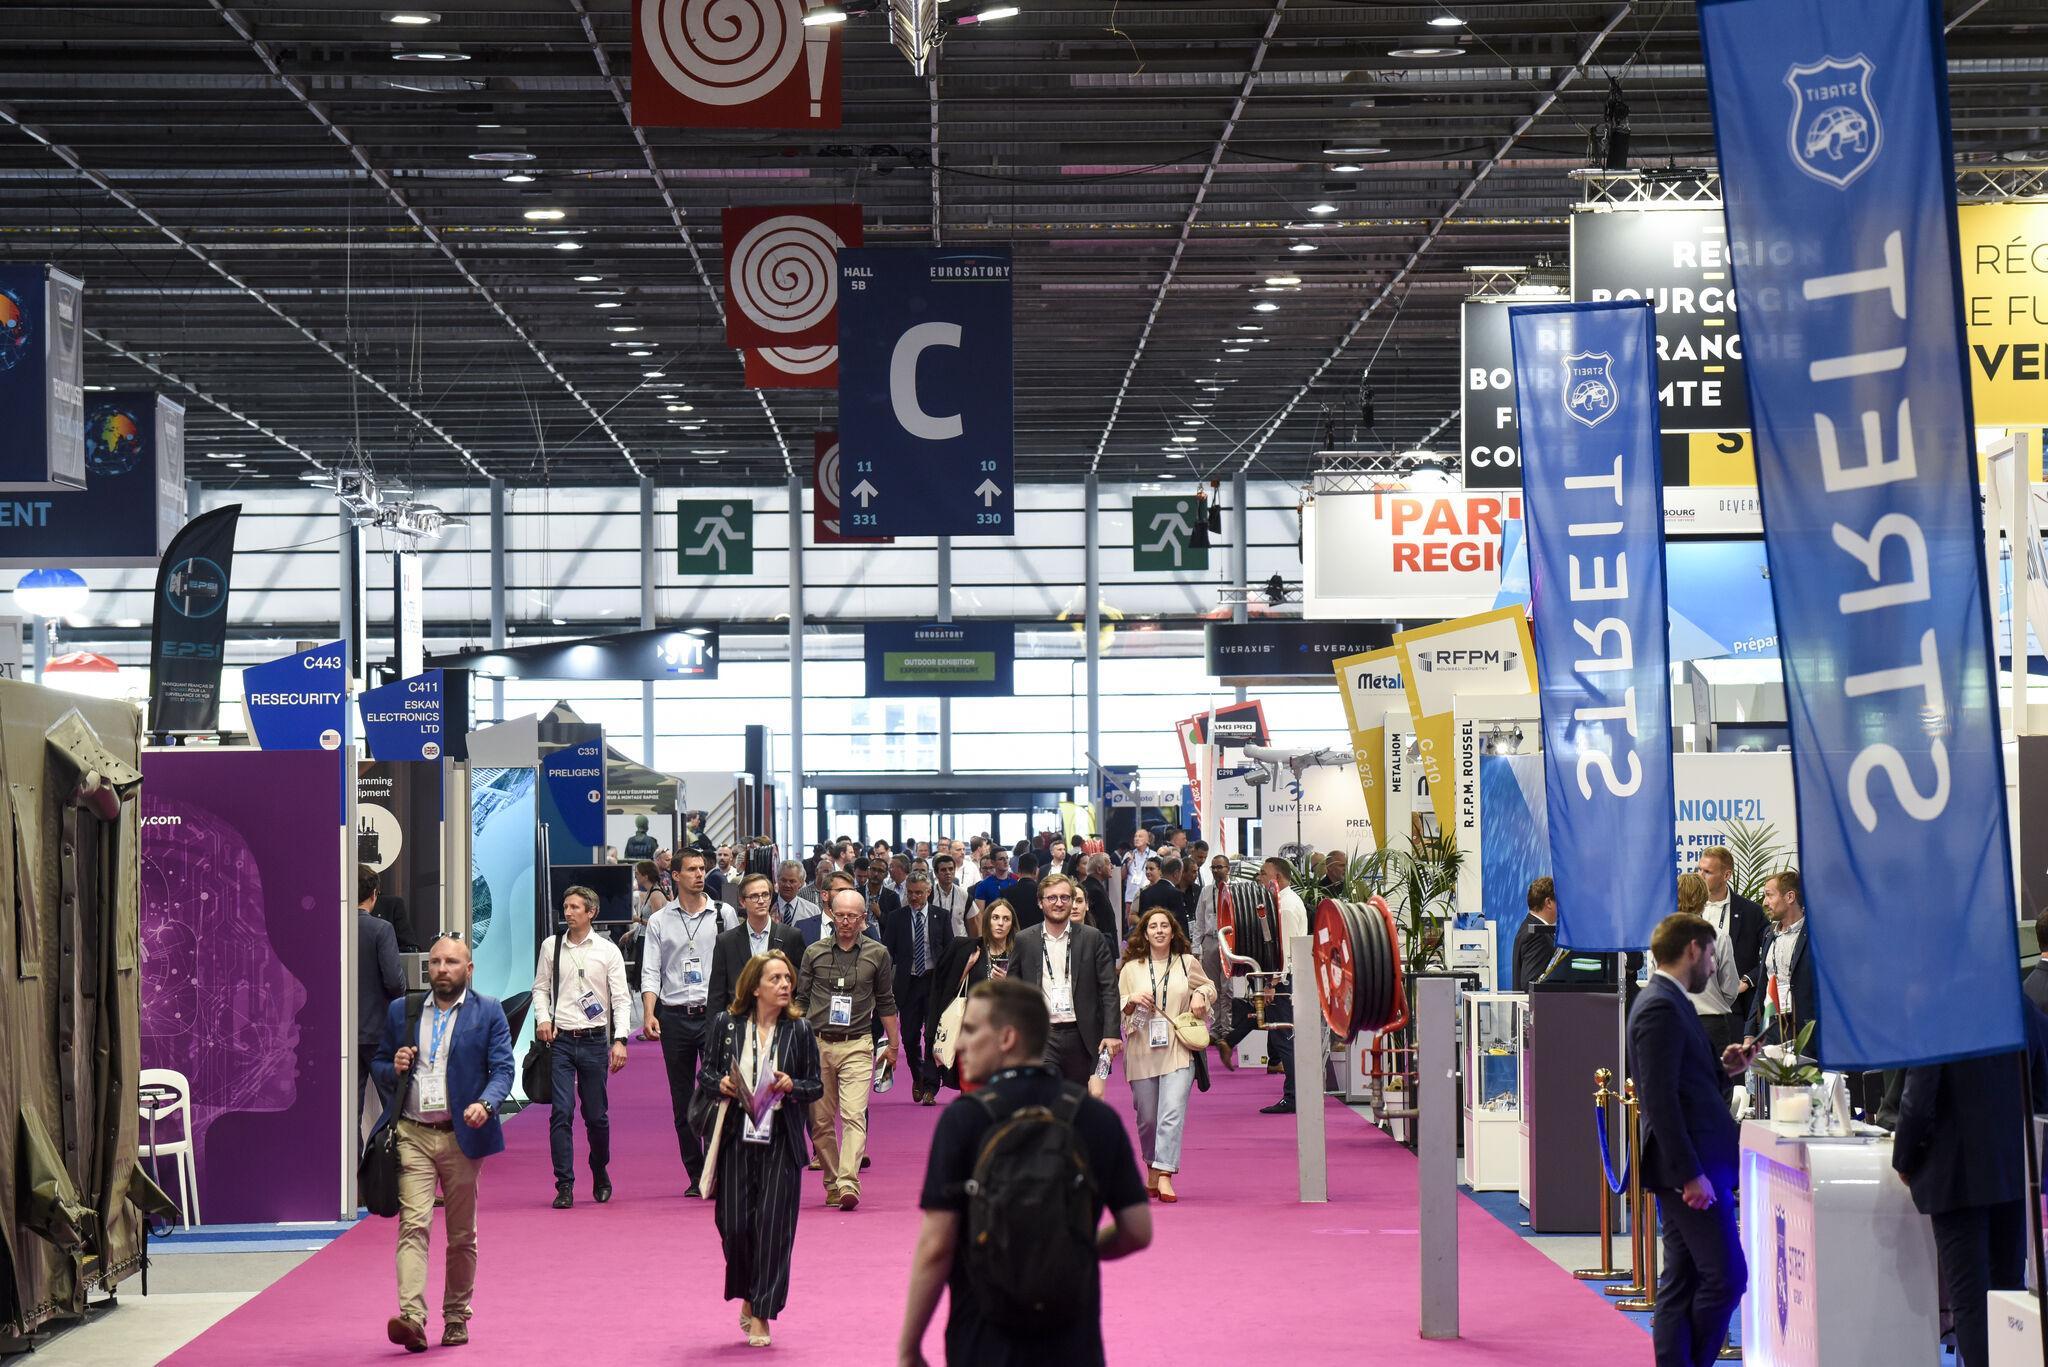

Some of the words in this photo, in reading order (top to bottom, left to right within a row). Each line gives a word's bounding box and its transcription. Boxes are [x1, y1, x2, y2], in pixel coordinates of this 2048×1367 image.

[844, 267, 874, 277] HALL
[930, 266, 1010, 277] EUROSATORY
[851, 281, 867, 290] 5B
[1972, 343, 2048, 382] VE
[889, 322, 964, 441] C
[857, 461, 873, 472] 11
[980, 460, 996, 471] 10
[0, 502, 52, 527] ENT
[853, 514, 878, 525] 331
[976, 514, 1001, 525] 330
[1392, 541, 1502, 573] REGI
[189, 580, 217, 590] EPSI
[914, 631, 964, 639] EUROSATORY
[161, 640, 221, 658] EPSI
[303, 656, 342, 669] C443
[1436, 650, 1499, 664] RFPM
[1358, 673, 1405, 690] Métal
[408, 682, 438, 693] C411
[251, 692, 341, 705] RESECURITY
[404, 700, 440, 709] ESKAN
[367, 712, 440, 722] ELECTRONICS
[420, 725, 440, 734] LTD
[1420, 738, 1434, 751] C
[1462, 720, 1473, 776] ROUSSEL
[577, 748, 599, 756] C331
[1356, 749, 1368, 760] C
[1391, 733, 1401, 792] METALHOM
[549, 769, 600, 777] PRELIGENS
[1424, 754, 1441, 783] 410
[1359, 763, 1374, 788] 378
[1268, 804, 1322, 813] UNIVEIRA
[1463, 780, 1474, 828] R.F.P.M.
[141, 815, 182, 828] y.com
[1688, 834, 1726, 846] PETITE
